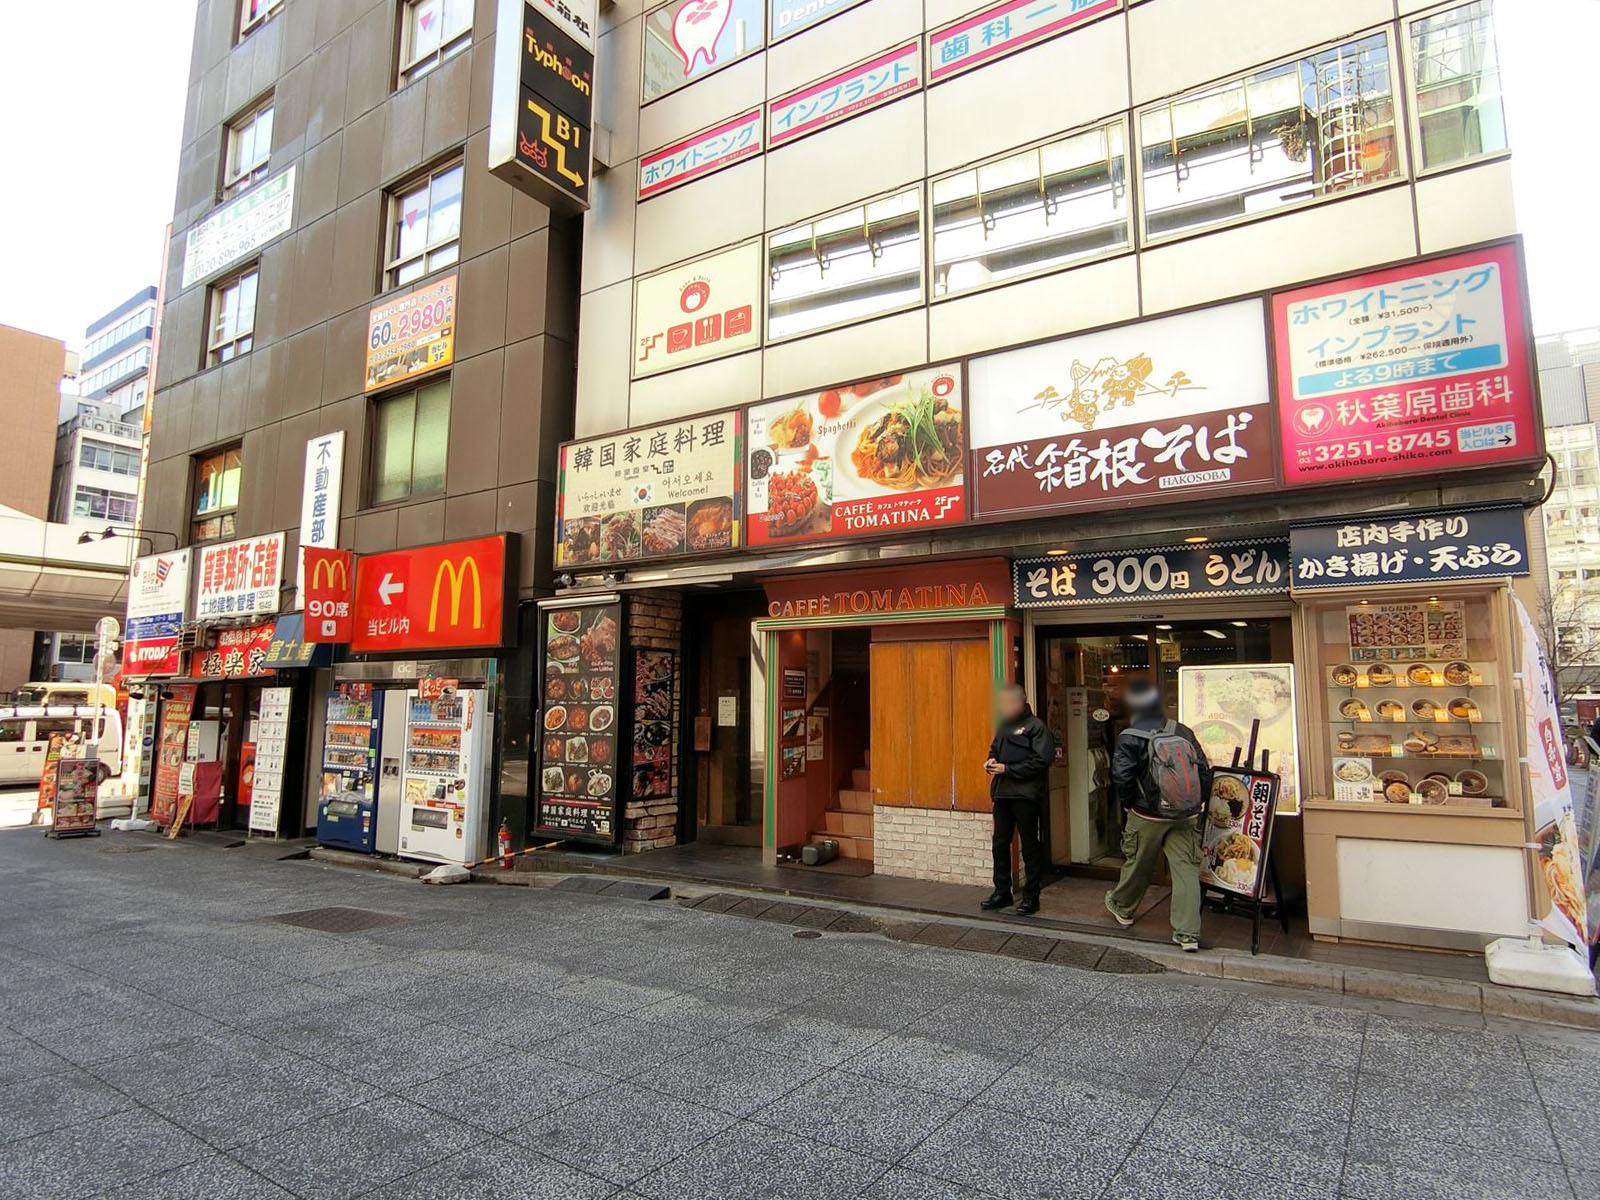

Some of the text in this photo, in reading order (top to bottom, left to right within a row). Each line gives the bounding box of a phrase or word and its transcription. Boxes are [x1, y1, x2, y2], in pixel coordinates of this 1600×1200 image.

[777, 63, 910, 128] インプラント
[556, 114, 580, 148] B1
[644, 123, 756, 185] ホワイトニング
[1293, 266, 1495, 325] ホワイトニング
[641, 336, 651, 346] 2F
[1307, 314, 1476, 358] インプラント
[1334, 352, 1461, 388] よる9時まで
[1336, 376, 1513, 427] 秋葉原歯科
[818, 418, 858, 437] Spaghetti
[573, 419, 725, 473] 韓国家庭料理
[983, 411, 1254, 493] 名代 箱根そば
[1316, 430, 1452, 462] 3251-8745
[311, 440, 332, 543] 不動産部
[668, 486, 709, 499] Welcome!
[1161, 470, 1228, 488] HAKOSOBA
[835, 501, 874, 518] CAFFÈ
[845, 507, 930, 529] TOMATINA
[935, 496, 948, 506] 2F
[1336, 515, 1469, 548] 店内手作り
[1026, 548, 1281, 598] そば 300円 うどん
[1298, 542, 1522, 580] かき揚げ・天ぷら
[308, 600, 350, 618] 90席
[768, 582, 990, 618] CAFFÈ TOMATINA
[367, 616, 410, 637] 当ビル内
[202, 648, 267, 677] 極楽家
[1248, 781, 1270, 839] 朝そば
